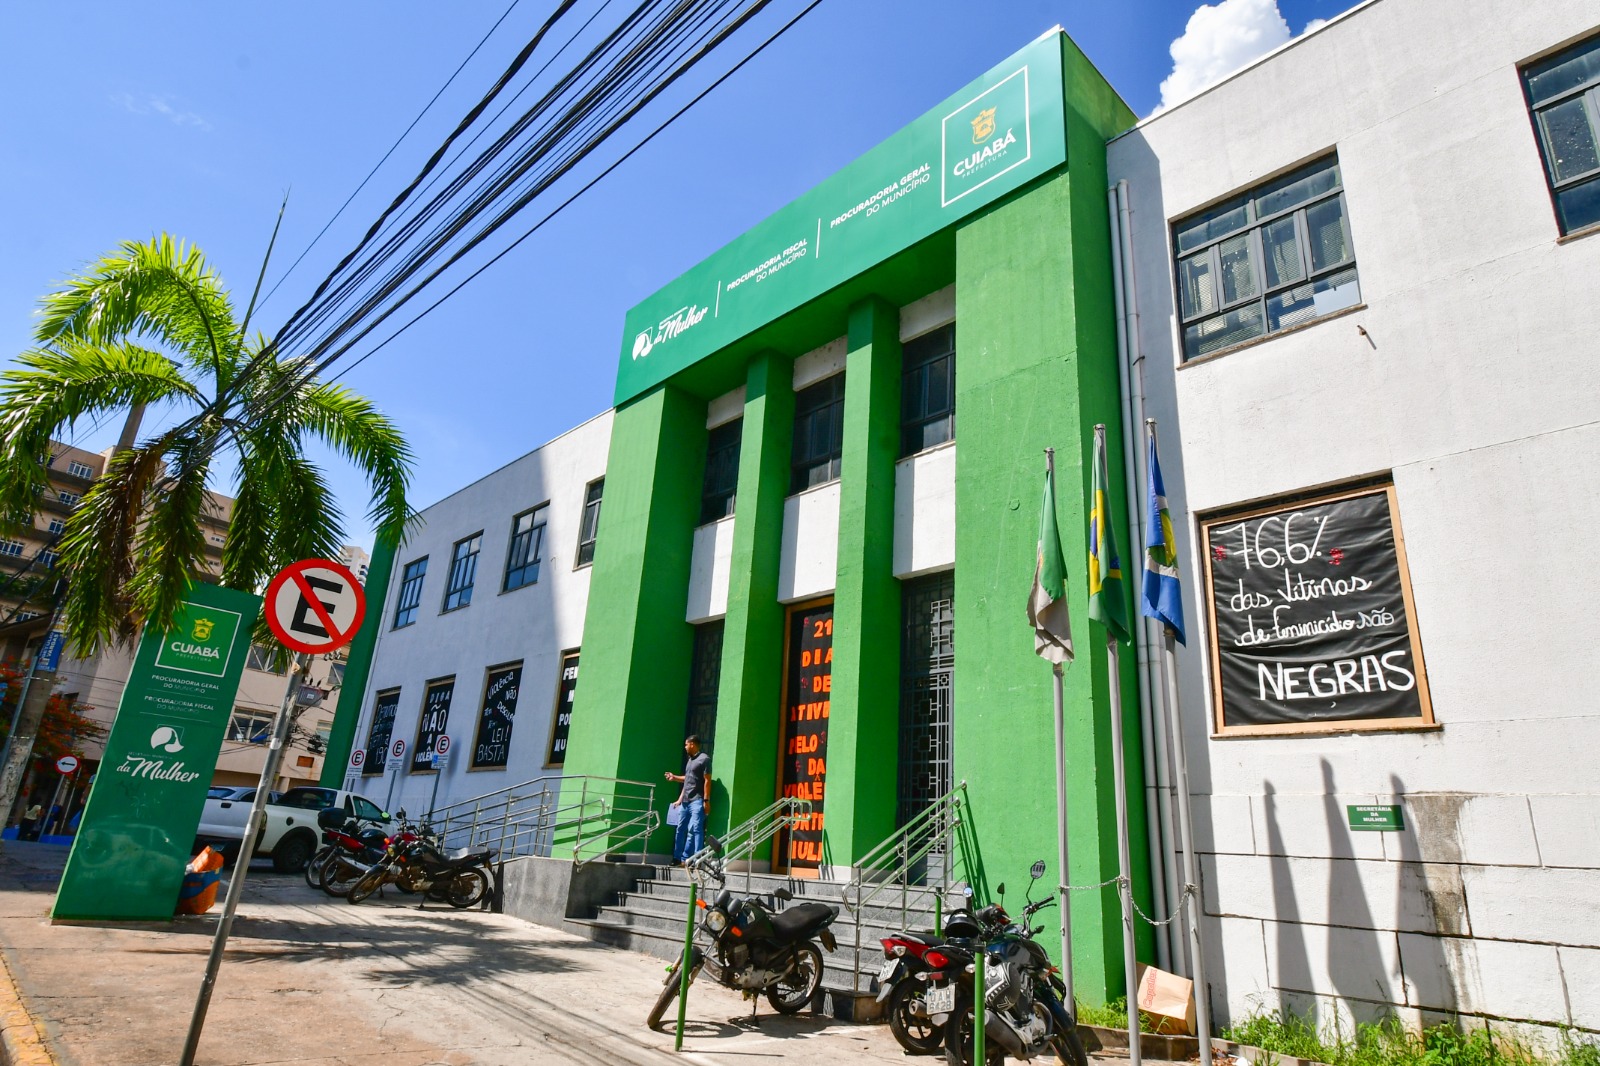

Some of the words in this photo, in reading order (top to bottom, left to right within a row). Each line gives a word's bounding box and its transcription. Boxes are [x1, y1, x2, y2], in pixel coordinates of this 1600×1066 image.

[953, 127, 1017, 176] CUIABÁ
[962, 150, 1008, 179] PREFEITURA
[830, 182, 899, 229] PROCURADORIA
[900, 162, 931, 186] GERAL
[866, 203, 880, 217] DO
[881, 173, 930, 208] MUNICÍPIO
[726, 253, 782, 292] PROCURADORIA
[782, 238, 808, 258] FISCAL
[756, 271, 767, 283] DO
[768, 247, 807, 276] MUNICÍPIO
[658, 304, 709, 344] Mulher
[1216, 512, 1329, 570] 76,6%
[290, 575, 343, 639] E
[1230, 578, 1273, 612] das
[813, 618, 833, 638] 21
[1234, 614, 1271, 647] de
[1356, 606, 1395, 630] são
[171, 641, 220, 659] CUIABÁ
[151, 674, 200, 687] PROCURADORIA
[200, 682, 219, 690] GERAL
[813, 674, 832, 693] DE
[1257, 650, 1415, 701] NEGRAS
[144, 695, 193, 708] PROCURADORIA
[194, 702, 214, 711] FISCAL
[421, 703, 447, 733] NÃO
[354, 753, 362, 763] E
[395, 743, 402, 754] E
[440, 739, 447, 750] E
[477, 743, 505, 763] BASTA
[788, 734, 819, 755] PELO
[116, 760, 131, 773] da
[126, 754, 200, 783] Mulher
[807, 758, 826, 776] DA
